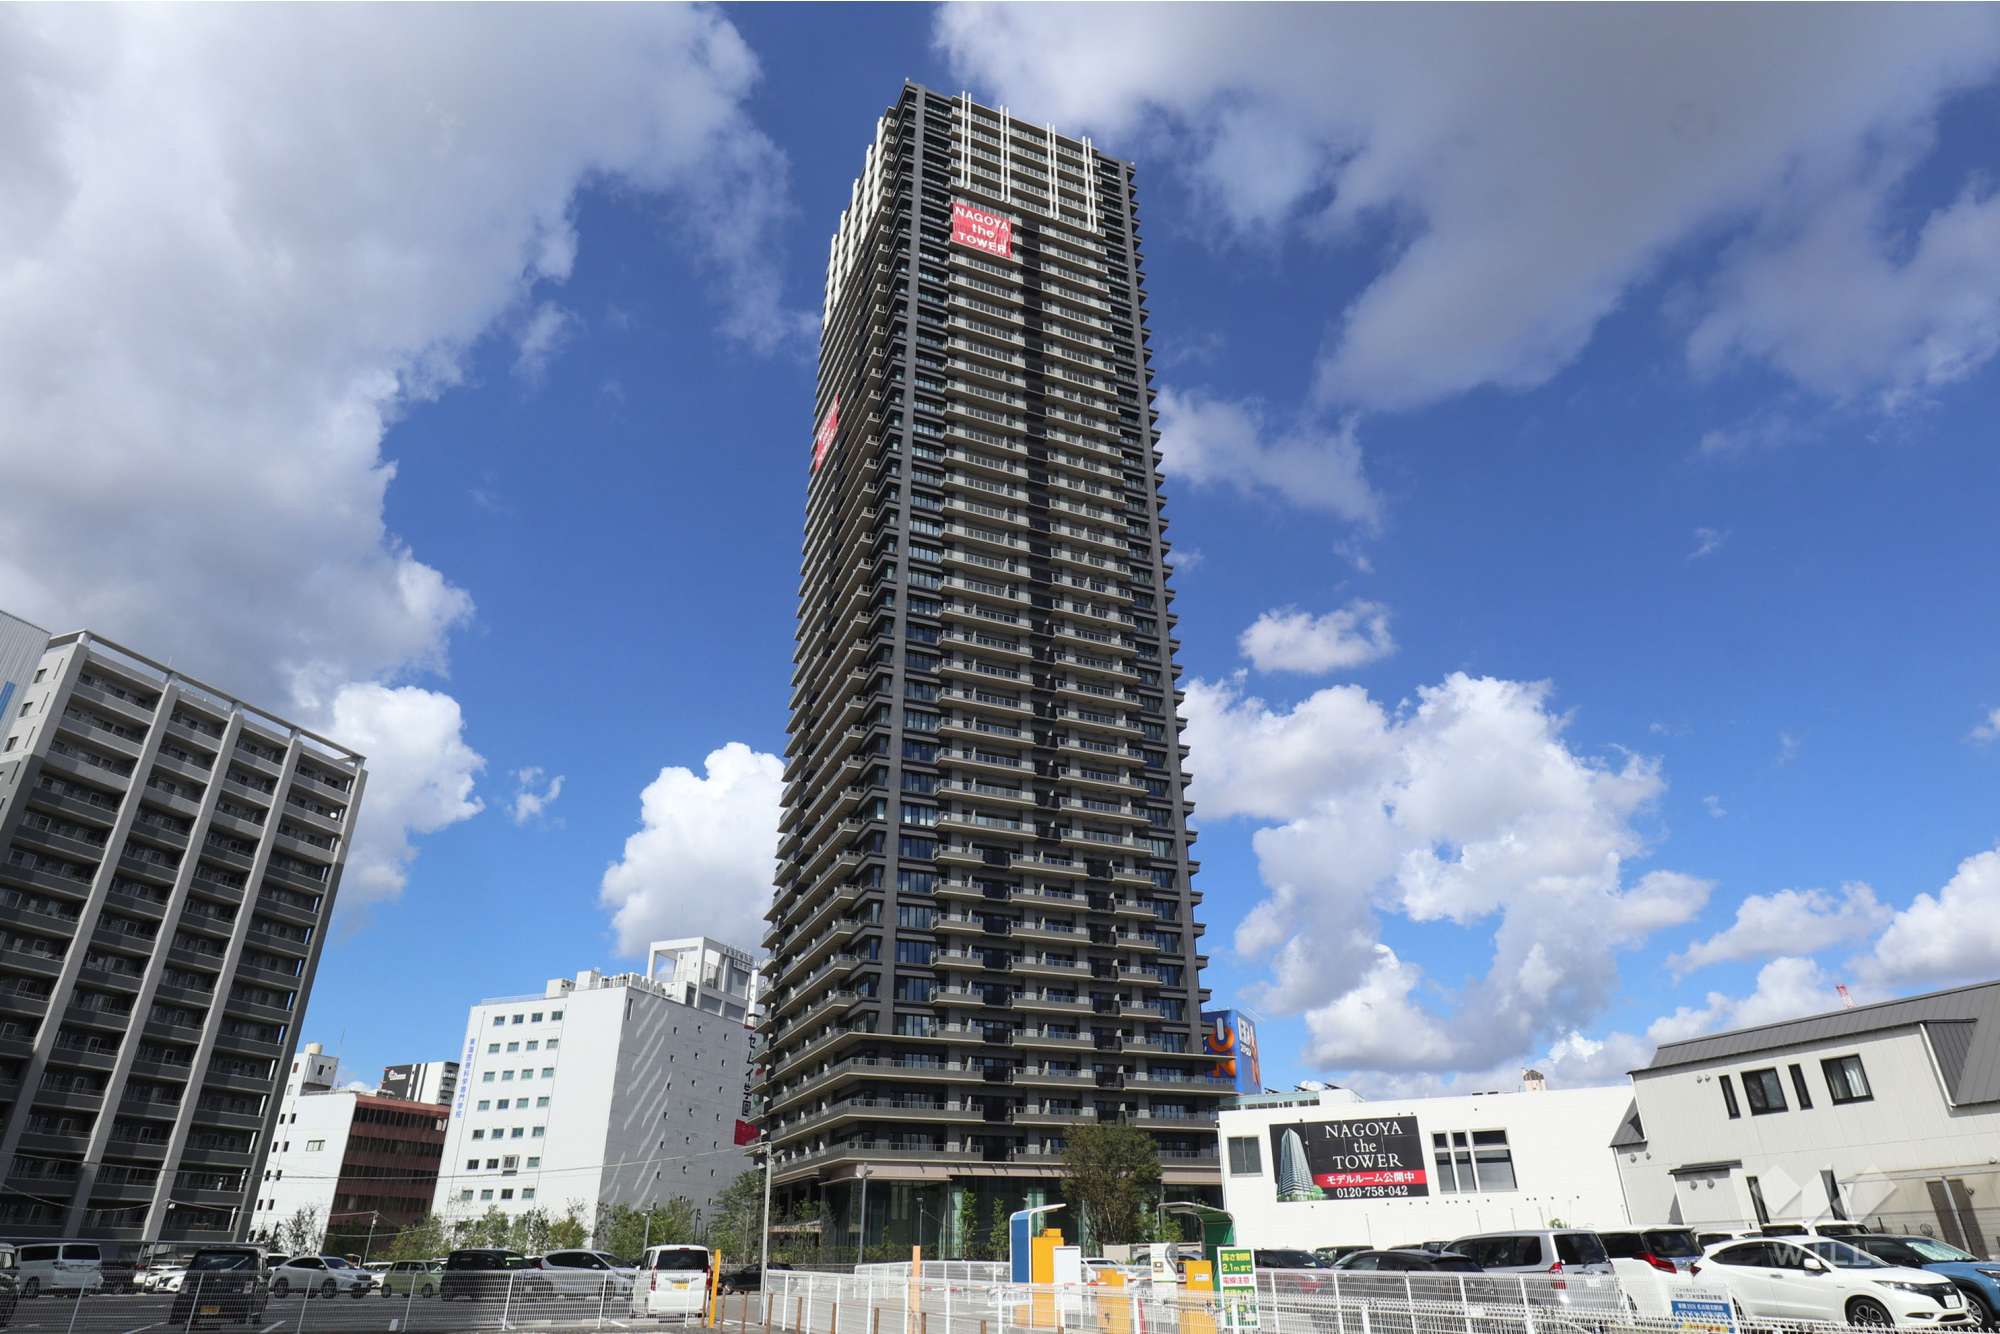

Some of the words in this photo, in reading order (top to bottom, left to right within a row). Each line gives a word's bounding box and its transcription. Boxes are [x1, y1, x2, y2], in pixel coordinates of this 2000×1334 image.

[955, 206, 1009, 232] NAGOYA
[972, 223, 995, 239] the
[958, 231, 1007, 255] TOWER
[1324, 1121, 1403, 1139] NAGOYA
[1353, 1139, 1377, 1153] the
[1332, 1153, 1404, 1170] TOWER
[1326, 1172, 1415, 1185] モデルルーム公開中
[1336, 1185, 1409, 1199] 0120-758-042
